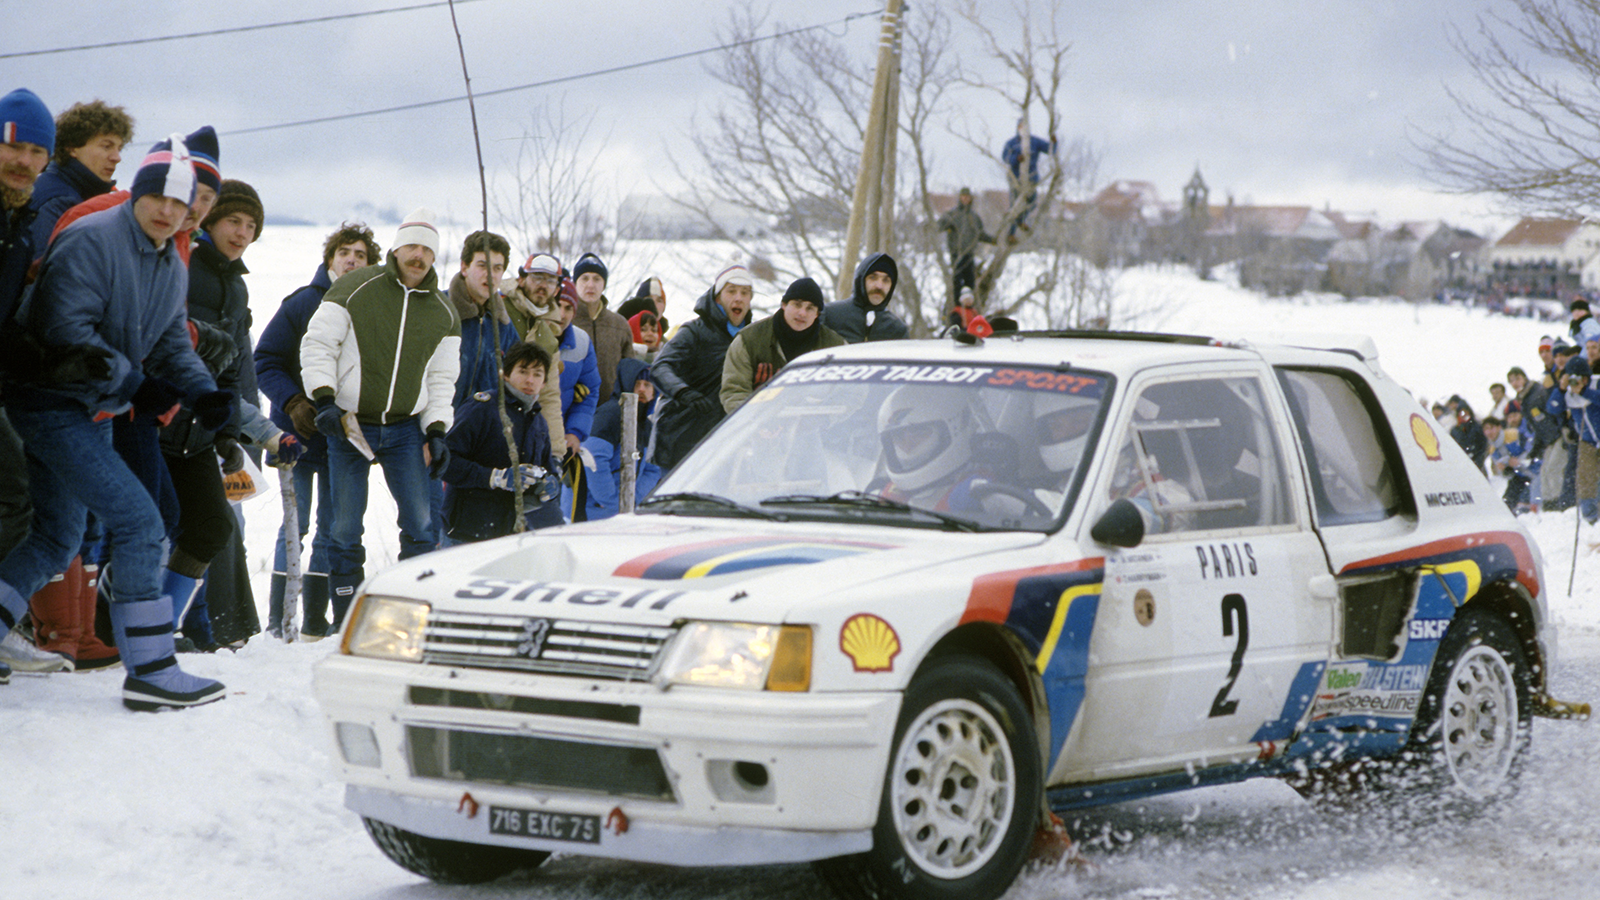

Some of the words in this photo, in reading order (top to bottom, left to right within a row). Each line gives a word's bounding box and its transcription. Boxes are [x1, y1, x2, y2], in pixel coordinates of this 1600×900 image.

[774, 364, 886, 385] PEUGEOT
[881, 366, 993, 384] TALBOT
[988, 368, 1097, 393] SPORT
[1424, 491, 1474, 507] MICHELIN
[1195, 542, 1257, 579] PARIS
[454, 578, 690, 611] Shell
[1410, 619, 1450, 639] SKF
[1208, 593, 1249, 718] 2
[1326, 668, 1362, 690] Valeo
[1360, 665, 1428, 691] BILSTEIN
[1345, 693, 1416, 711] speedline
[492, 809, 521, 832] 716
[527, 812, 563, 837] EXC
[570, 816, 595, 840] 75
